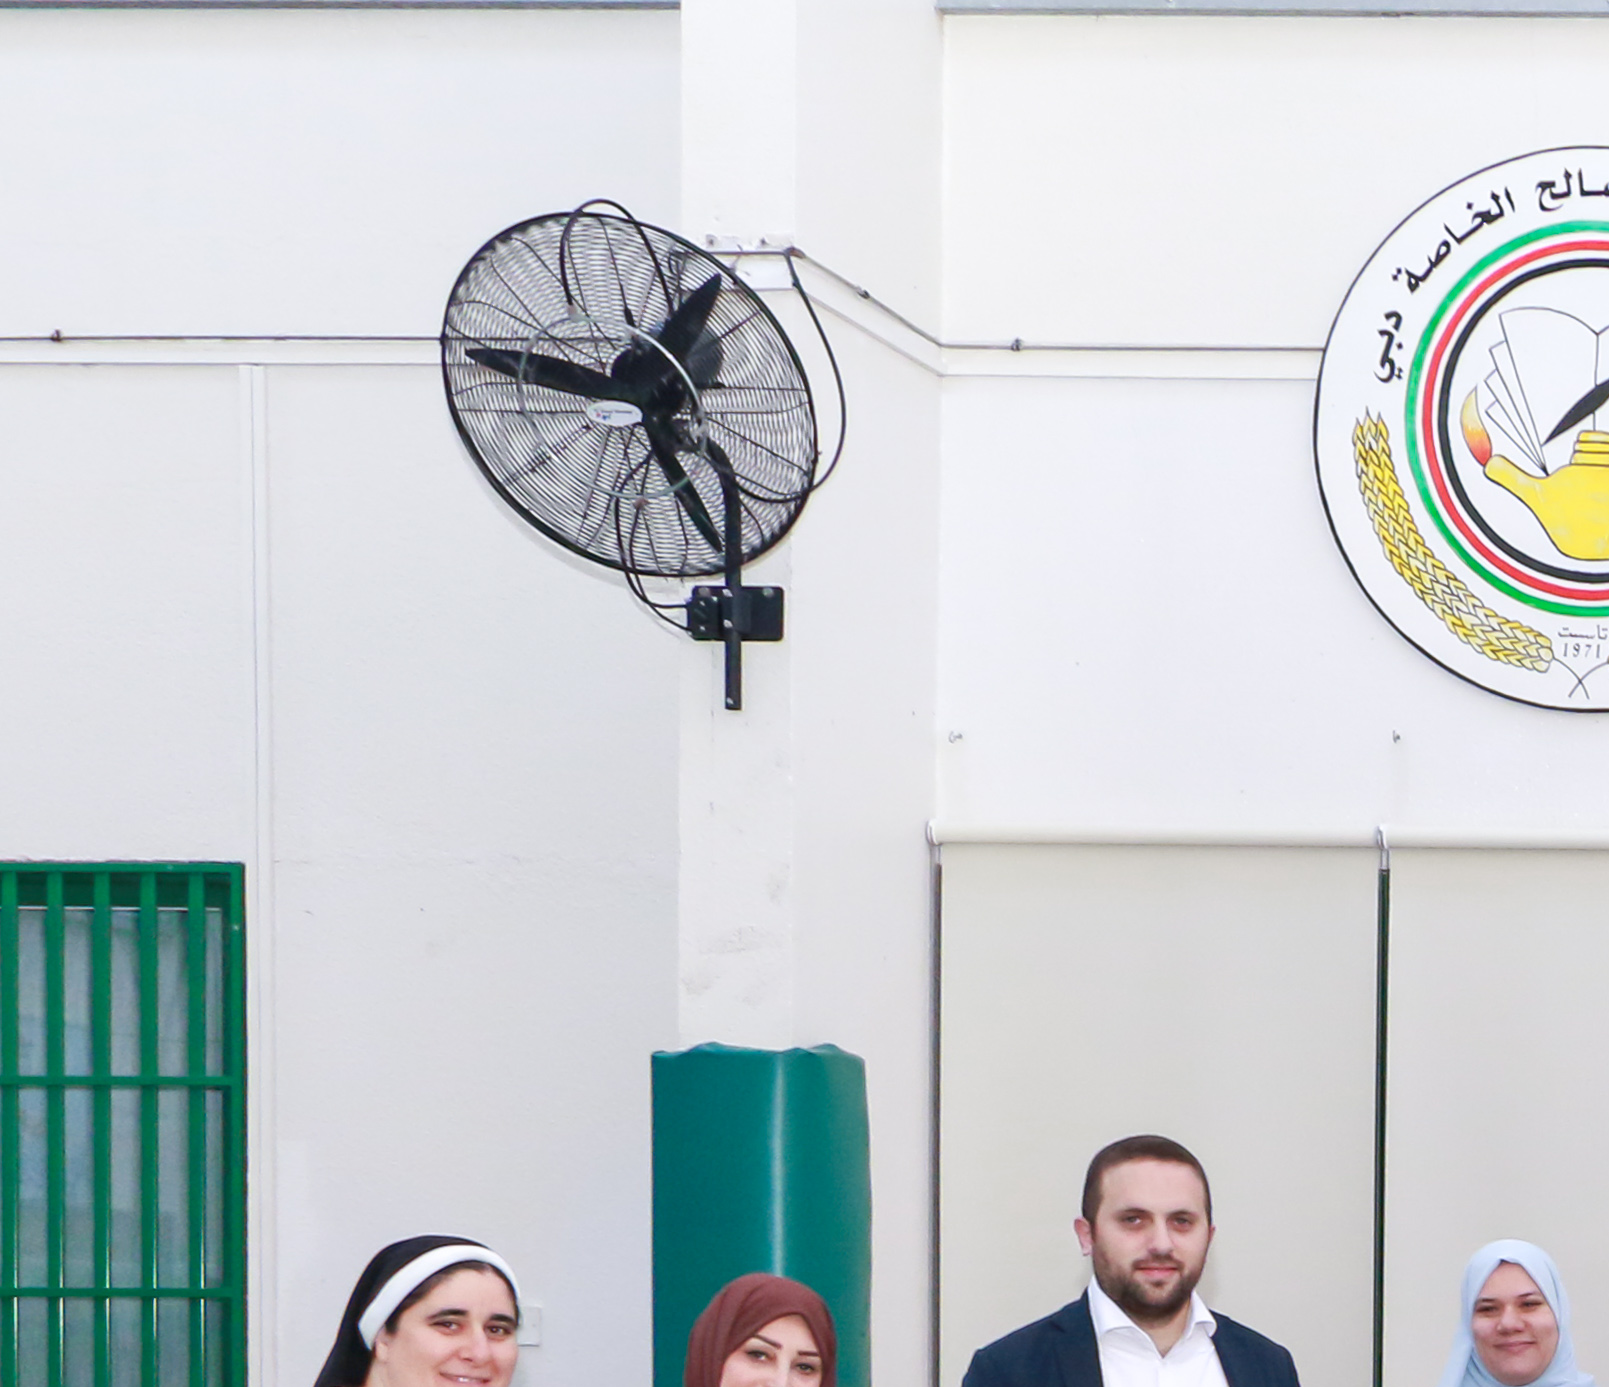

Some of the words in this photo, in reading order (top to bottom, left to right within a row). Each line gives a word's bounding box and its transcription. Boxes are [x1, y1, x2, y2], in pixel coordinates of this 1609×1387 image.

[1392, 186, 1515, 295] الخاصة
[1373, 310, 1403, 384] دبي
[1563, 643, 1600, 658] 1971
